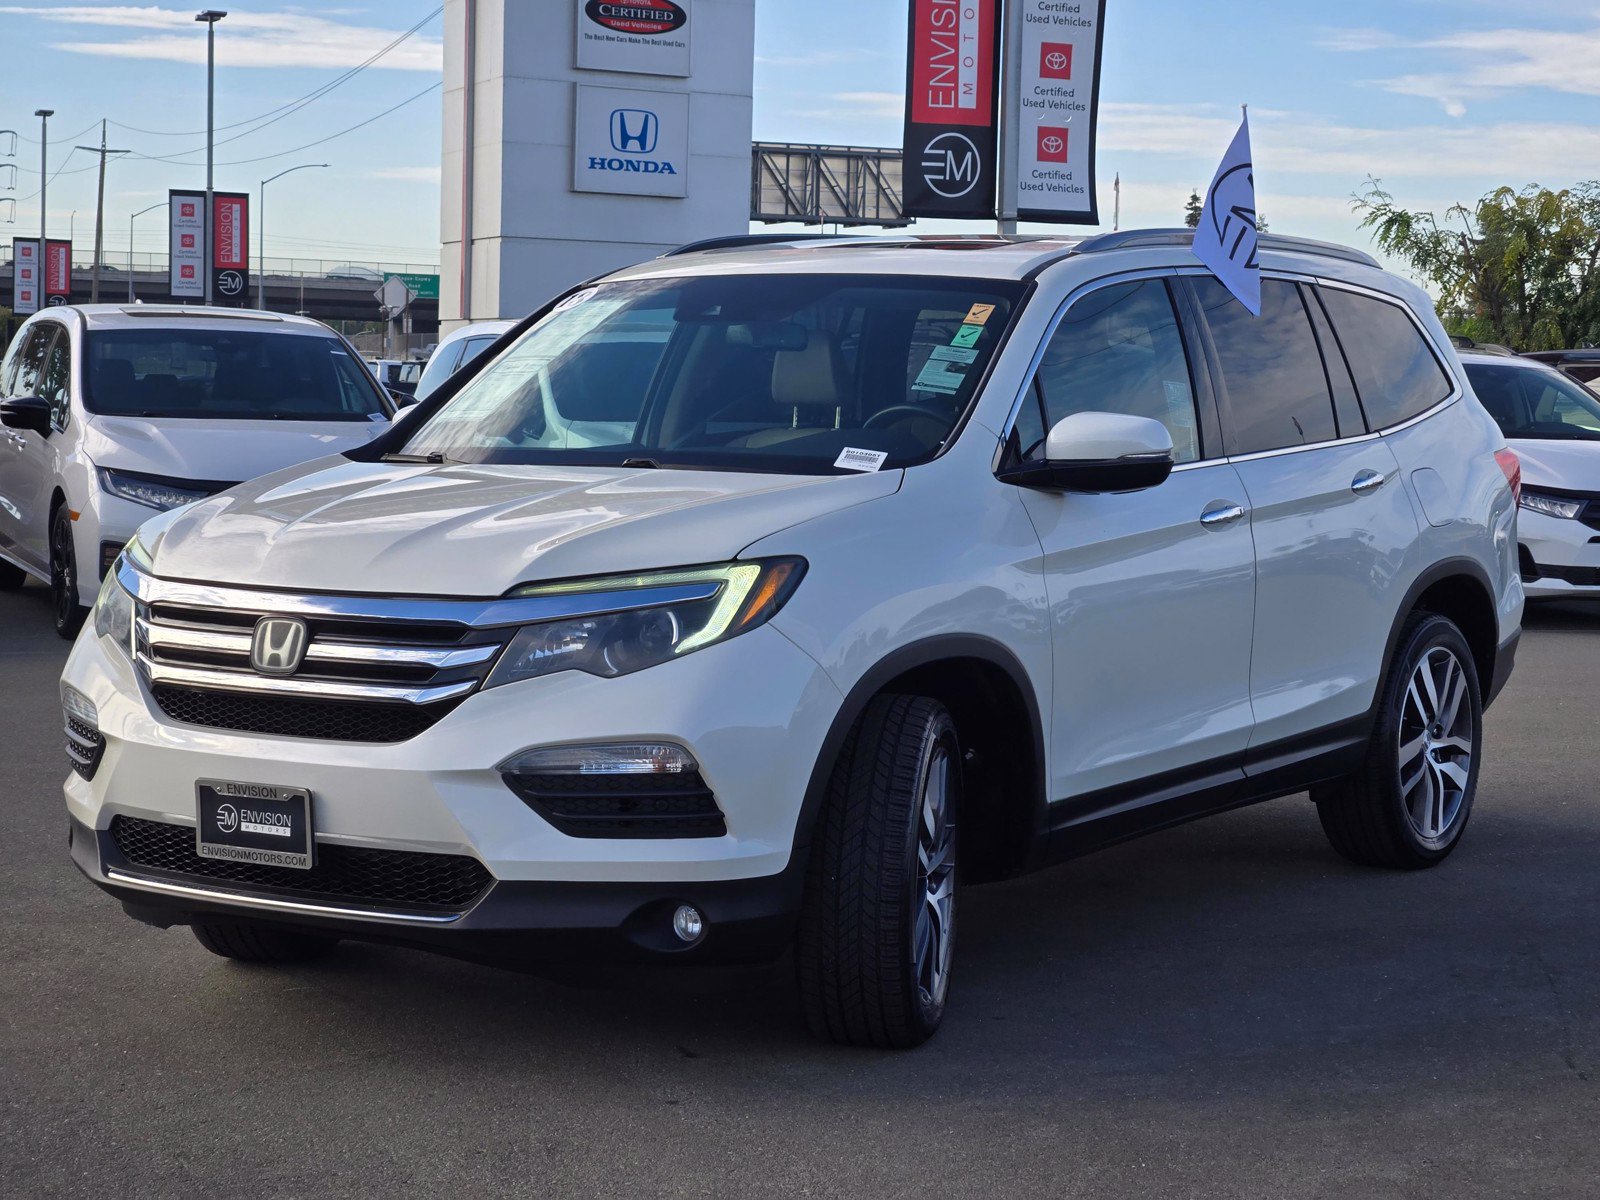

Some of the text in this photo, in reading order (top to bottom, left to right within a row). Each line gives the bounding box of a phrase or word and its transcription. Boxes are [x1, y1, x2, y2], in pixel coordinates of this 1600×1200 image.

[599, 4, 674, 20] CERTIFIED
[1038, 2, 1080, 13] Certified
[632, 21, 662, 30] Vehicles
[1026, 14, 1092, 28] Used Vehicles
[1034, 86, 1075, 97] Certified
[1022, 98, 1086, 112] Used Vehicles
[588, 157, 677, 174] HONDA
[1031, 170, 1072, 180] Certified
[1020, 182, 1085, 194] Used Vehicles
[221, 203, 232, 263] ENVISION
[227, 784, 277, 798] ENVISION
[241, 809, 291, 826] ENVISION
[245, 825, 287, 834] MOTORS
[202, 846, 306, 866] ENVISIONMOTORS.COM
